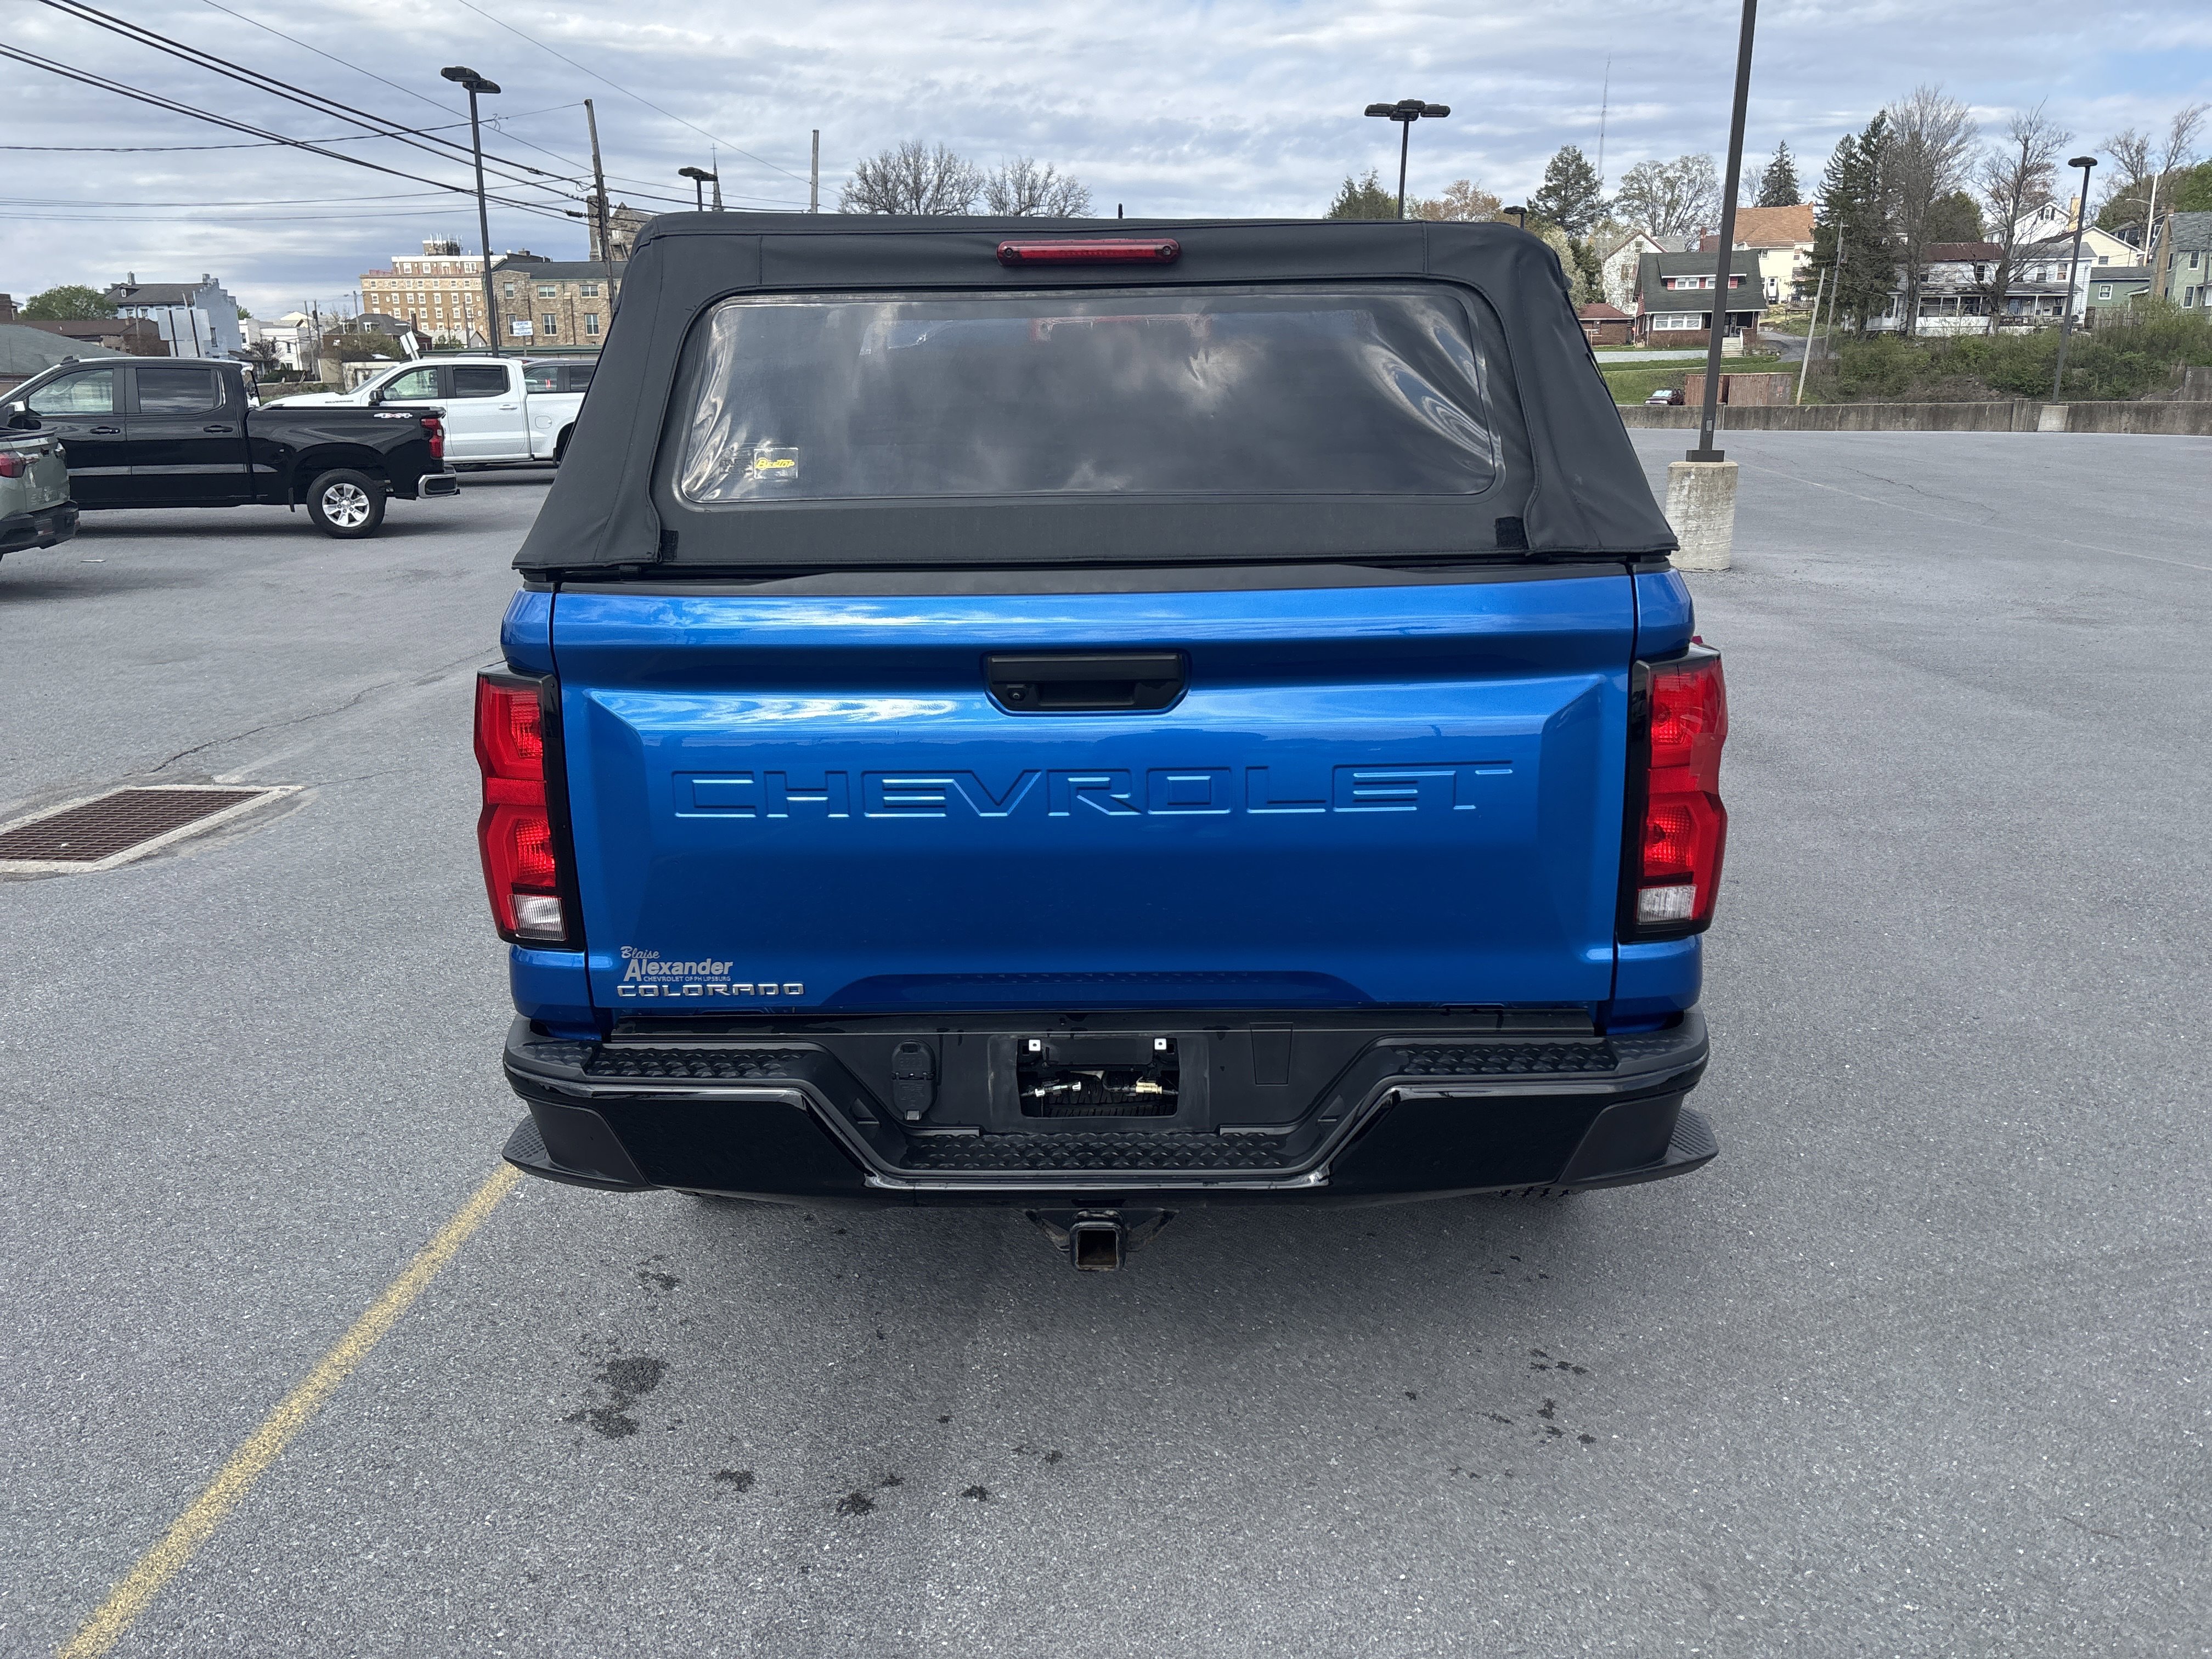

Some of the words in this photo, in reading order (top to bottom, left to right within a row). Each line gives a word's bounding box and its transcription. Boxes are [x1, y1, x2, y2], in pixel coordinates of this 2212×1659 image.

[672, 760, 1513, 818] CHEVROLET
[620, 946, 660, 959] Blaise
[623, 958, 733, 981] Alexander
[617, 983, 805, 997] COLORADO
